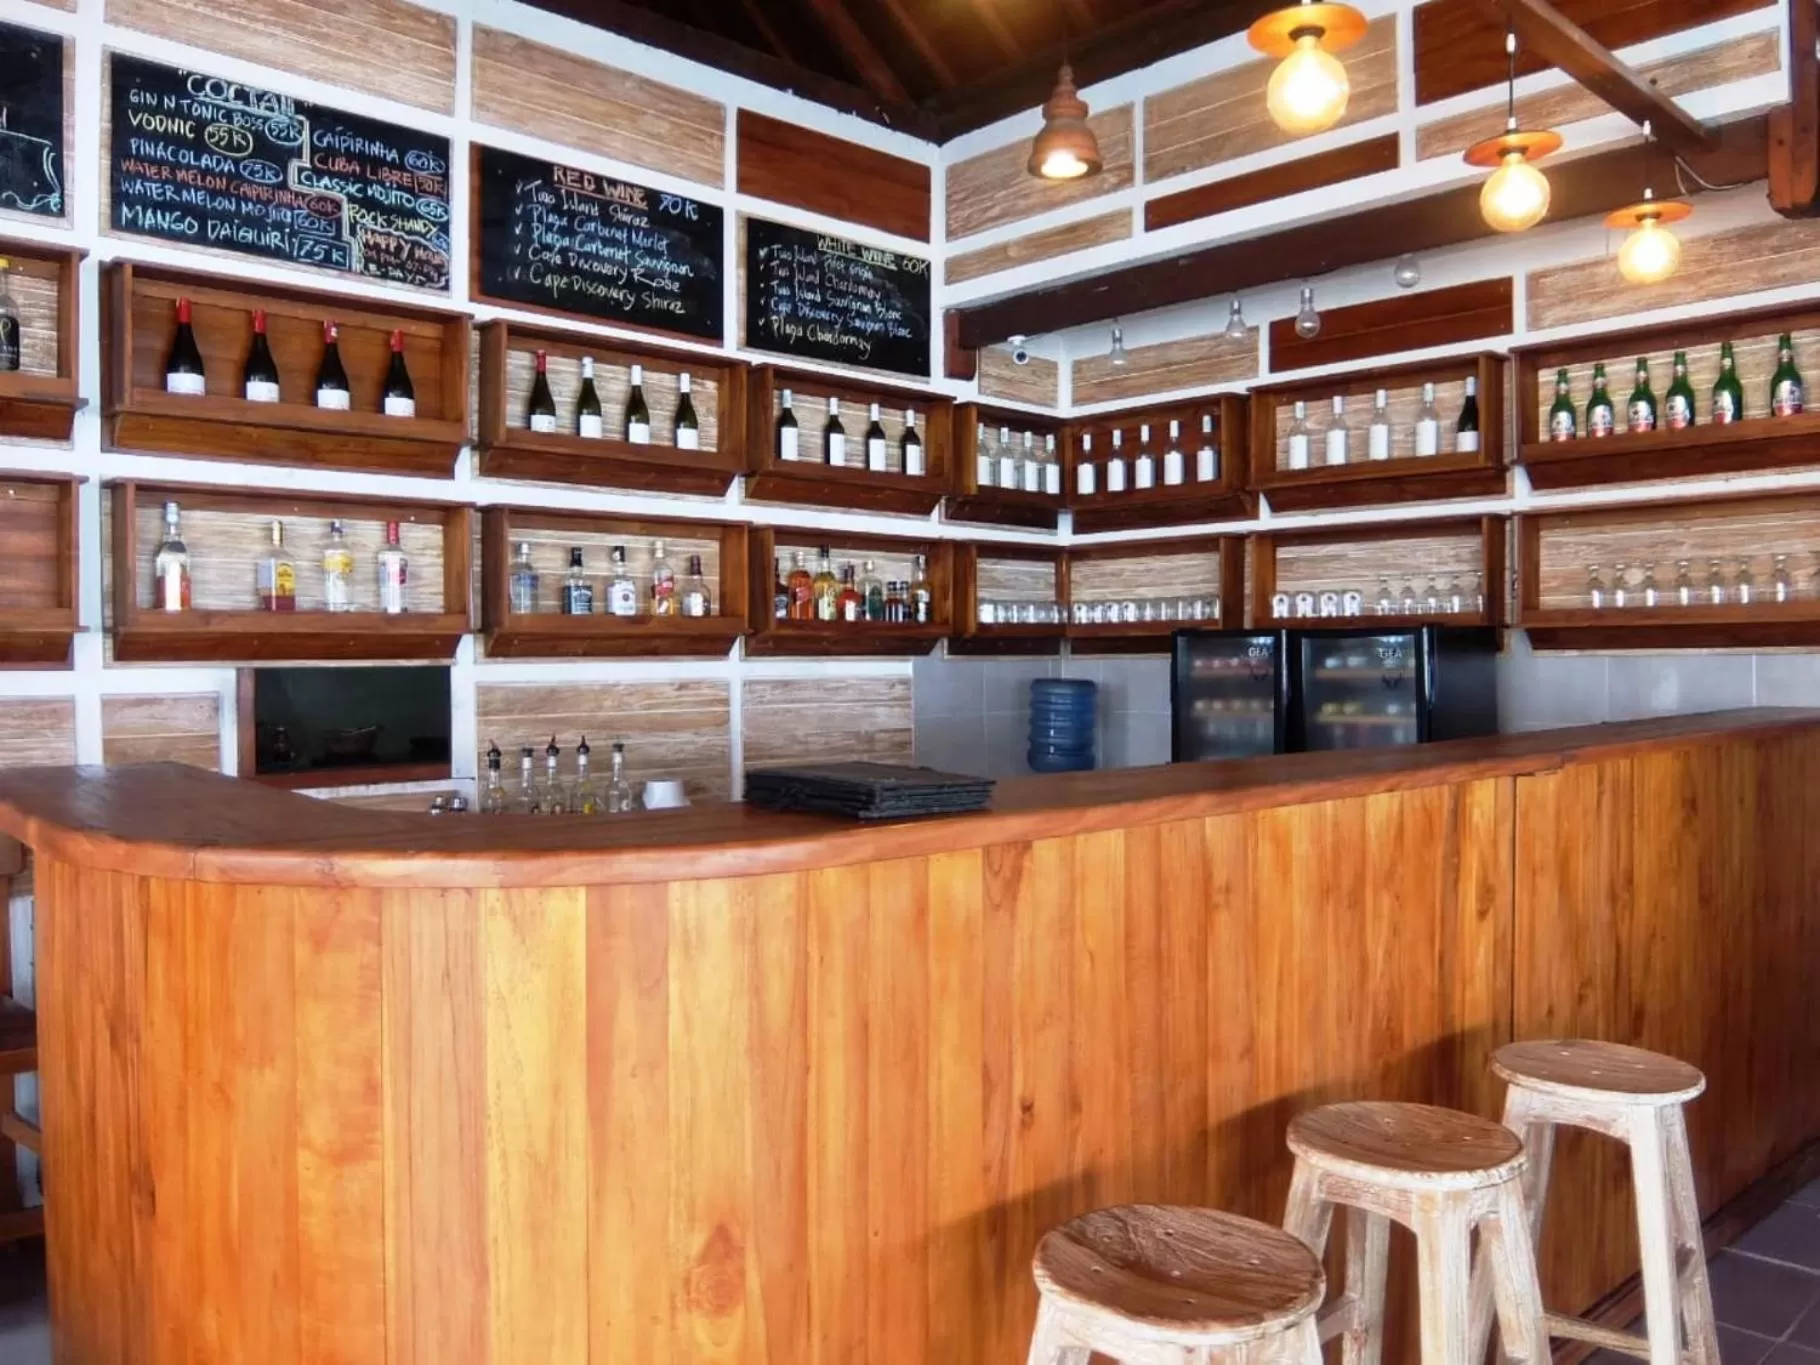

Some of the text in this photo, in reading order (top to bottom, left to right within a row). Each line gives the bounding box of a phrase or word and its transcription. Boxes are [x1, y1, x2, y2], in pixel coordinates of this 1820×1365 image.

[129, 89, 157, 105] GIN
[164, 95, 176, 109] N
[178, 99, 228, 123] TONIC
[128, 109, 247, 148] VODNIC 55K
[312, 128, 400, 165] CAIPIRINHA
[120, 158, 172, 179] WATER
[176, 169, 226, 192] MELON
[310, 197, 338, 213] 60K
[244, 163, 277, 181] 75K
[314, 153, 360, 175] CUBA
[367, 166, 413, 188] LIBRE
[552, 165, 595, 192] RED
[602, 180, 648, 208] WINE
[121, 178, 180, 202] WATER
[182, 187, 235, 212] MELON
[298, 214, 333, 232] 60K
[301, 171, 447, 217] CLASSIC MOJITO 65K
[121, 203, 198, 235] MANGO
[347, 203, 440, 240] ROCK SHANDY
[609, 204, 650, 228] Shiraz
[362, 229, 411, 261] HAPPY
[817, 236, 857, 258] WHITE
[529, 263, 686, 314] Cape Discovery Shiraz
